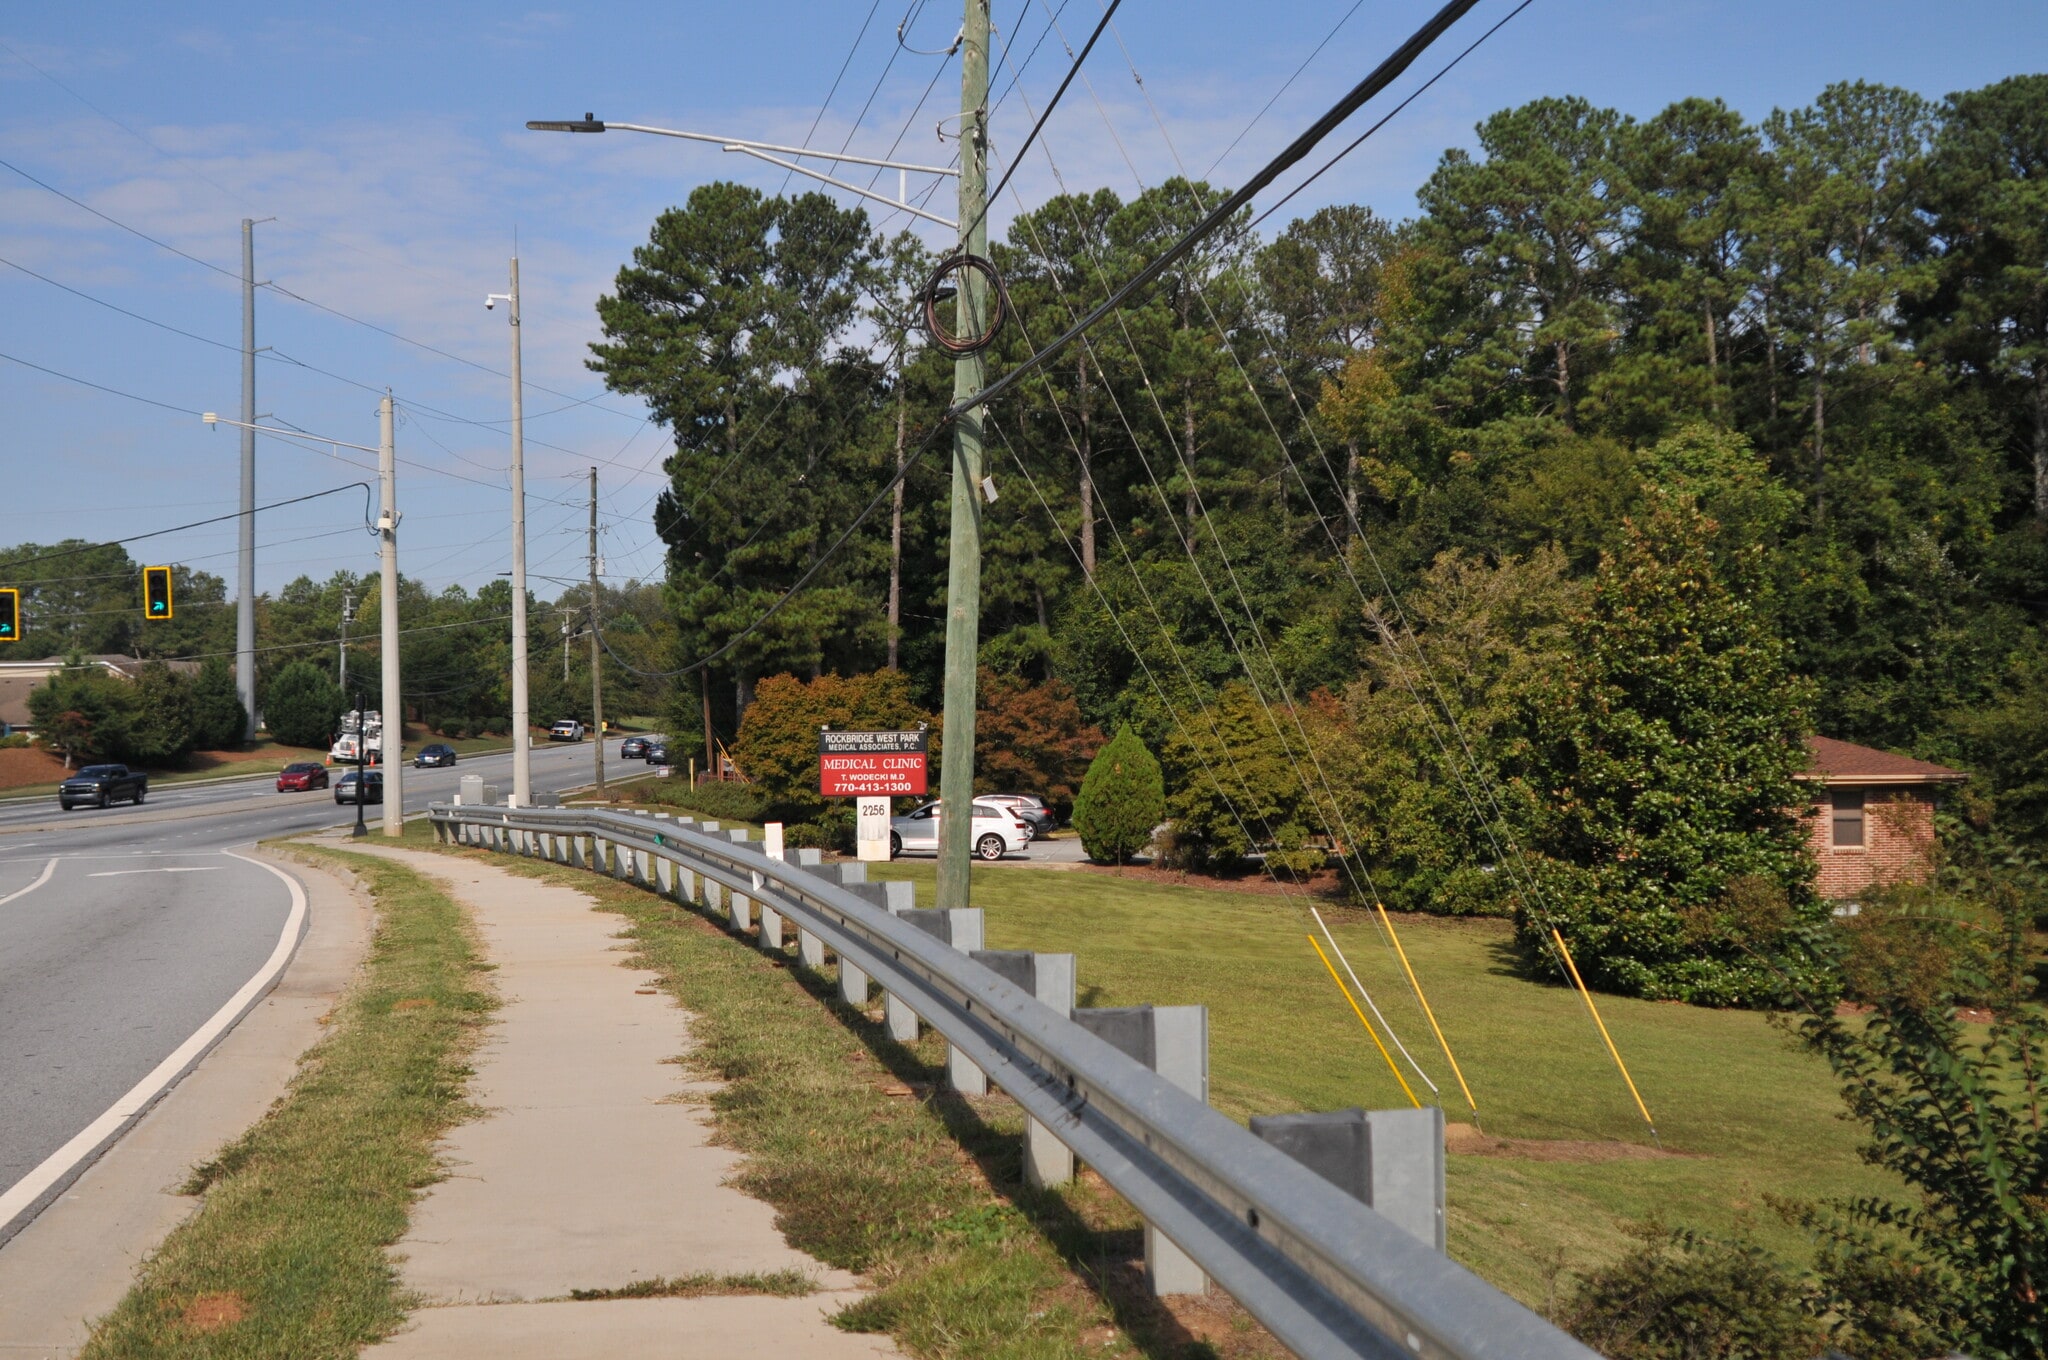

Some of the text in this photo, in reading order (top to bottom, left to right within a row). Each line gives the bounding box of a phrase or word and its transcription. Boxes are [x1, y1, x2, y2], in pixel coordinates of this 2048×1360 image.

[825, 734, 920, 743] ROCKBRIDGE WEST PARK
[828, 743, 857, 751] MEDICAL
[824, 758, 922, 769] MEDICAL CLINIC
[834, 783, 911, 791] 770-413-1300
[862, 804, 885, 816] 2256
